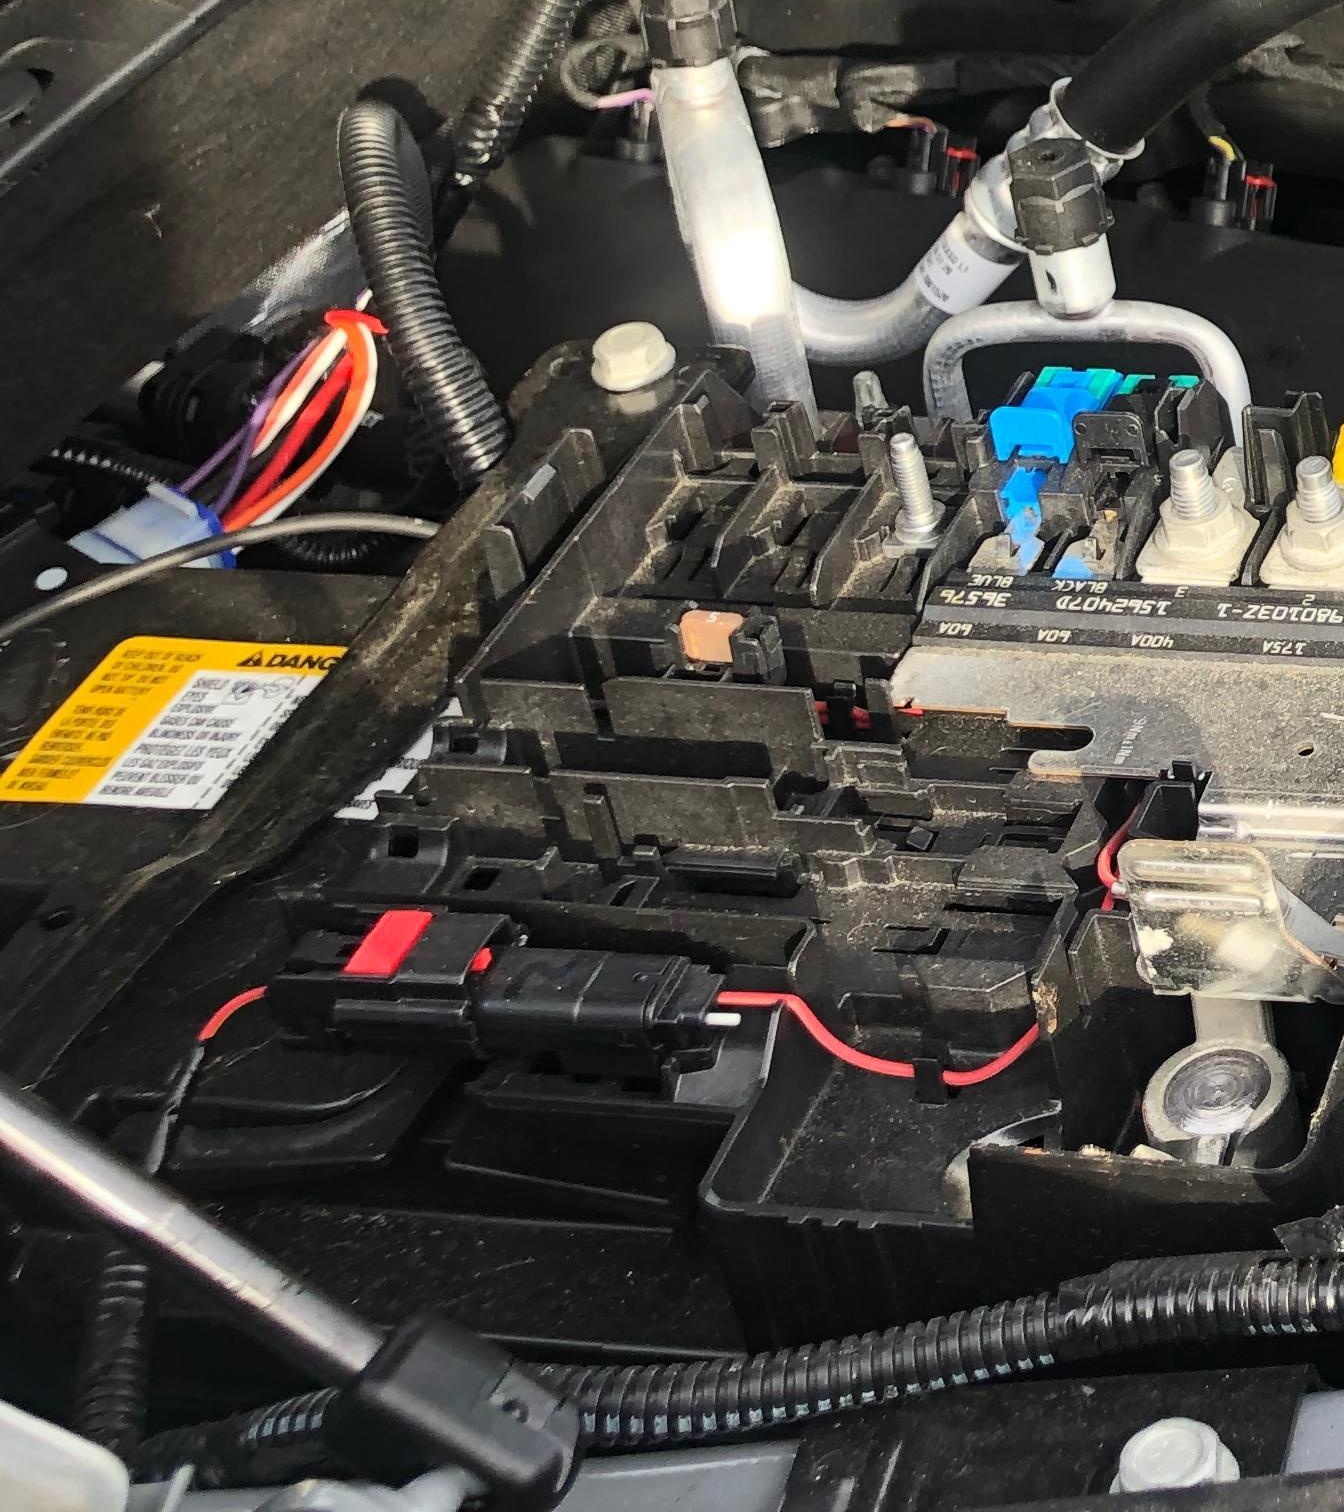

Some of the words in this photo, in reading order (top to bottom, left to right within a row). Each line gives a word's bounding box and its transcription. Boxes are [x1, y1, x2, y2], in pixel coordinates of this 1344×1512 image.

[967, 573, 1015, 589] BLUE
[1051, 579, 1110, 595] BLACK
[939, 589, 1012, 608] 36576
[1174, 586, 1190, 598] 3
[1055, 595, 1172, 616] 1562407D
[1301, 594, 1317, 607] 2
[938, 622, 974, 637] 60A
[1036, 629, 1073, 644] 60A
[1130, 634, 1175, 649] 400A
[1262, 640, 1308, 656] 175A
[264, 654, 343, 670] DANG
